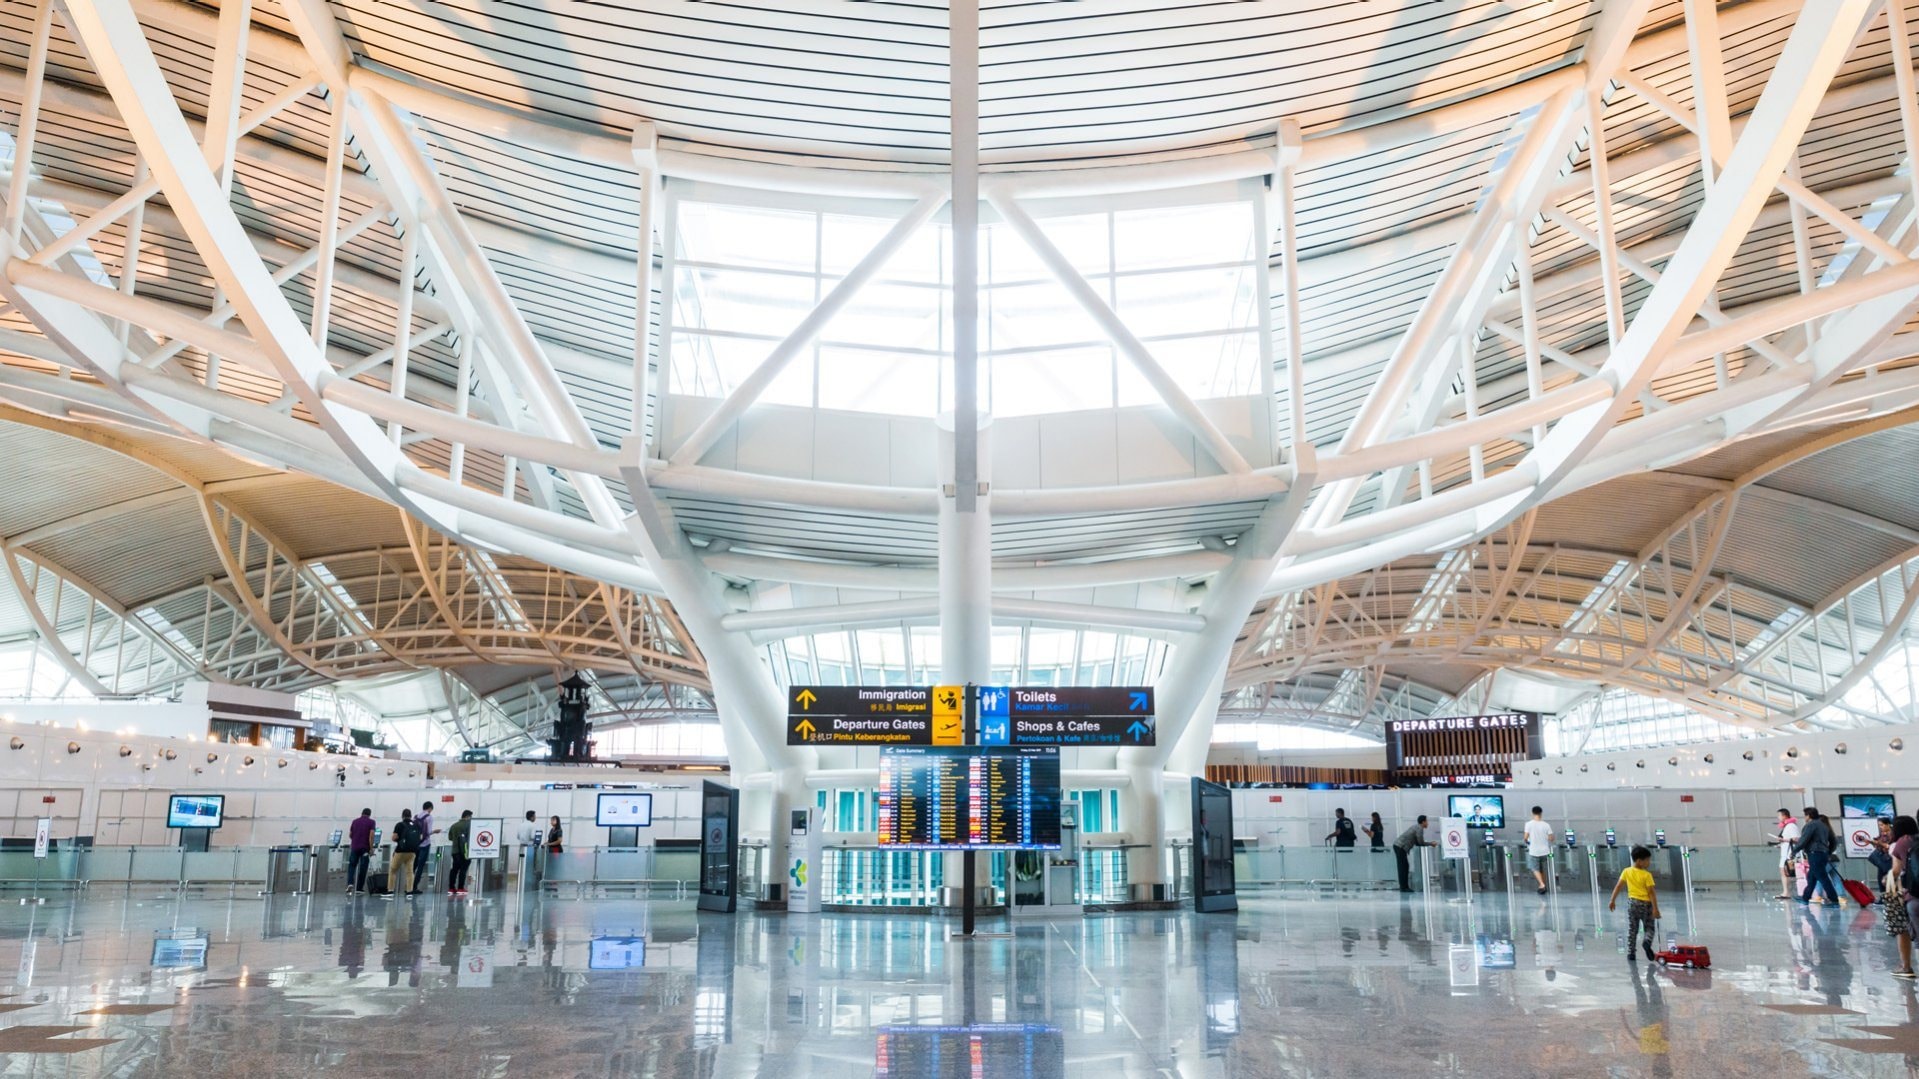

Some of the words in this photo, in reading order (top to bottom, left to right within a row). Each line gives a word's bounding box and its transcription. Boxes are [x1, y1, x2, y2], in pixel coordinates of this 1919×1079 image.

[859, 690, 926, 701] Immigration
[1016, 691, 1057, 702] Toilets
[896, 703, 927, 712] Imigrasi
[833, 719, 890, 732] Departure
[892, 719, 926, 730] Gates
[1016, 721, 1053, 733] Shops
[1056, 721, 1065, 731] &
[1068, 721, 1101, 731] Cafes
[1393, 719, 1474, 731] DEPARTURE
[1479, 715, 1528, 726] GATES
[833, 733, 853, 741] Pintu
[855, 733, 911, 742] Keberangkatan
[1431, 776, 1448, 784] BALI
[1476, 775, 1495, 783] FREE
